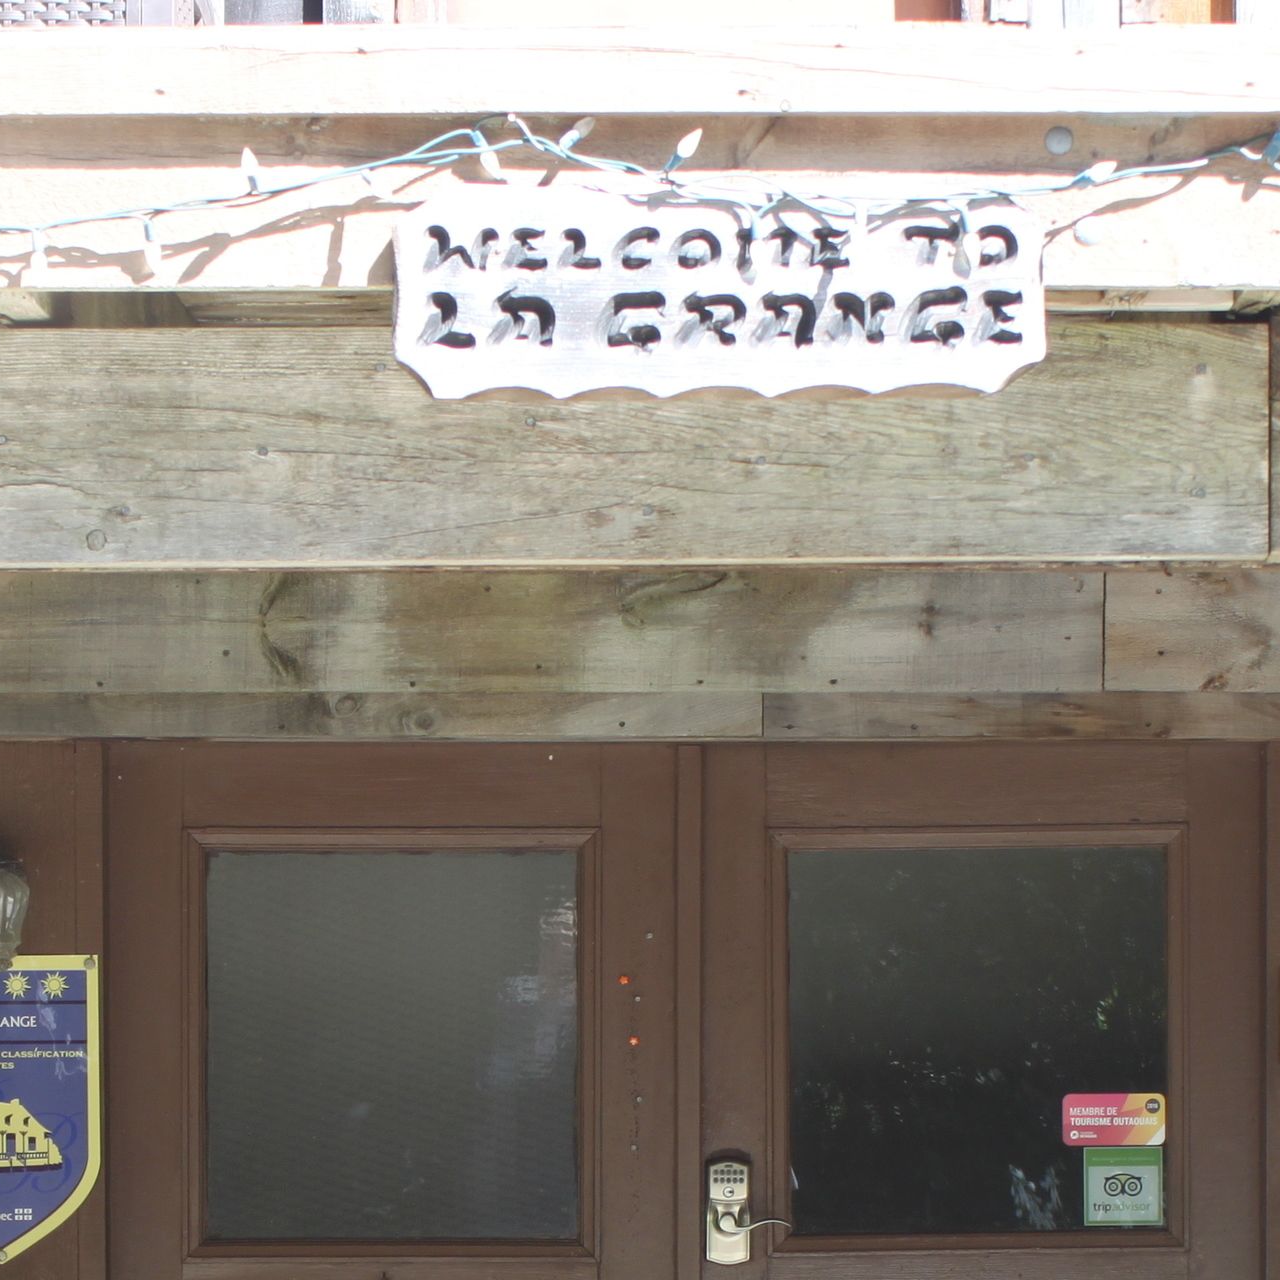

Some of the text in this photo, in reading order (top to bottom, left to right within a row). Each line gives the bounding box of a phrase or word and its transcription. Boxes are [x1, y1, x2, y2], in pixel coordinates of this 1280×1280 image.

[424, 222, 1018, 271] WELCOME TO
[419, 285, 1024, 351] LA GRANGE
[1069, 1107, 1118, 1116] MEMBRE DE
[1070, 1117, 1158, 1126] TOURISME OUTAOUAIS
[1093, 1201, 1151, 1214] tripadvisor
